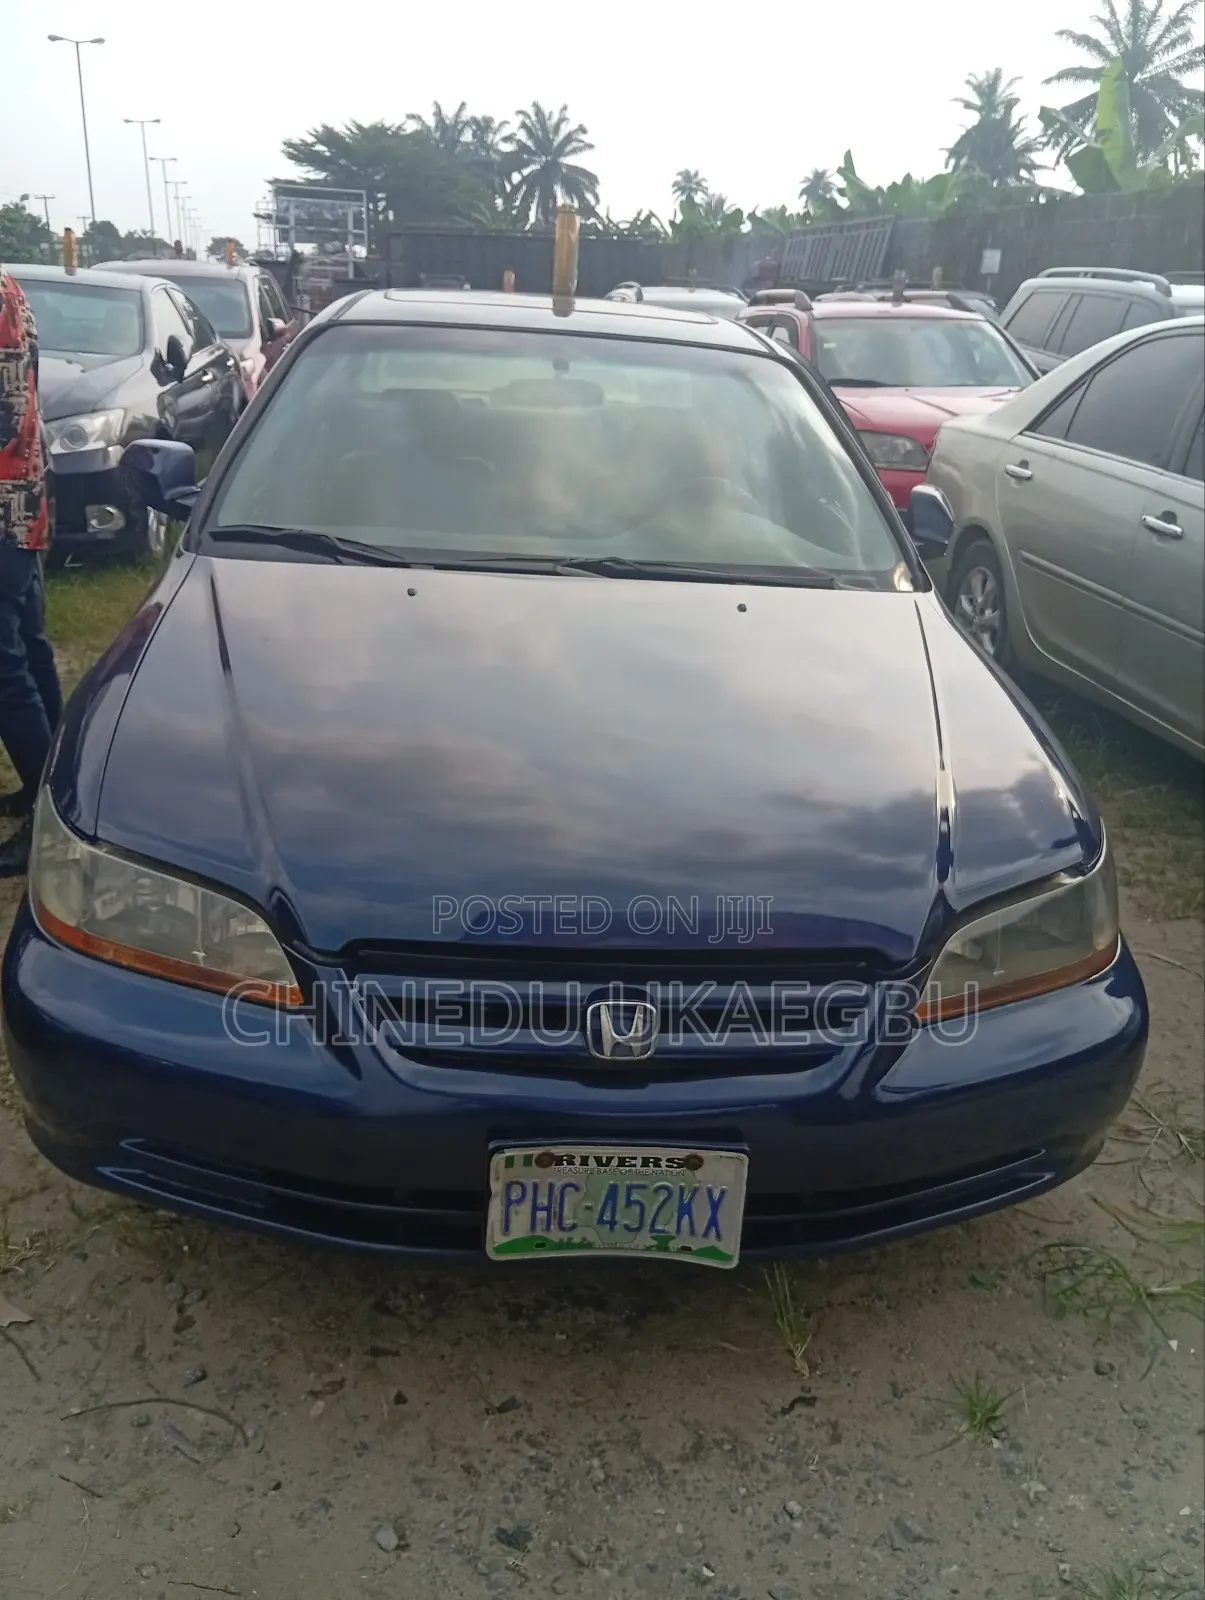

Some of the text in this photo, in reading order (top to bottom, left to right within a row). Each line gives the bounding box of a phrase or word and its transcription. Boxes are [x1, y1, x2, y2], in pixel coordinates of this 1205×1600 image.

[552, 1154, 686, 1169] RIVERS
[553, 1167, 594, 1175] TREASURE
[596, 1168, 617, 1176] BASE
[651, 1169, 685, 1177] NATION
